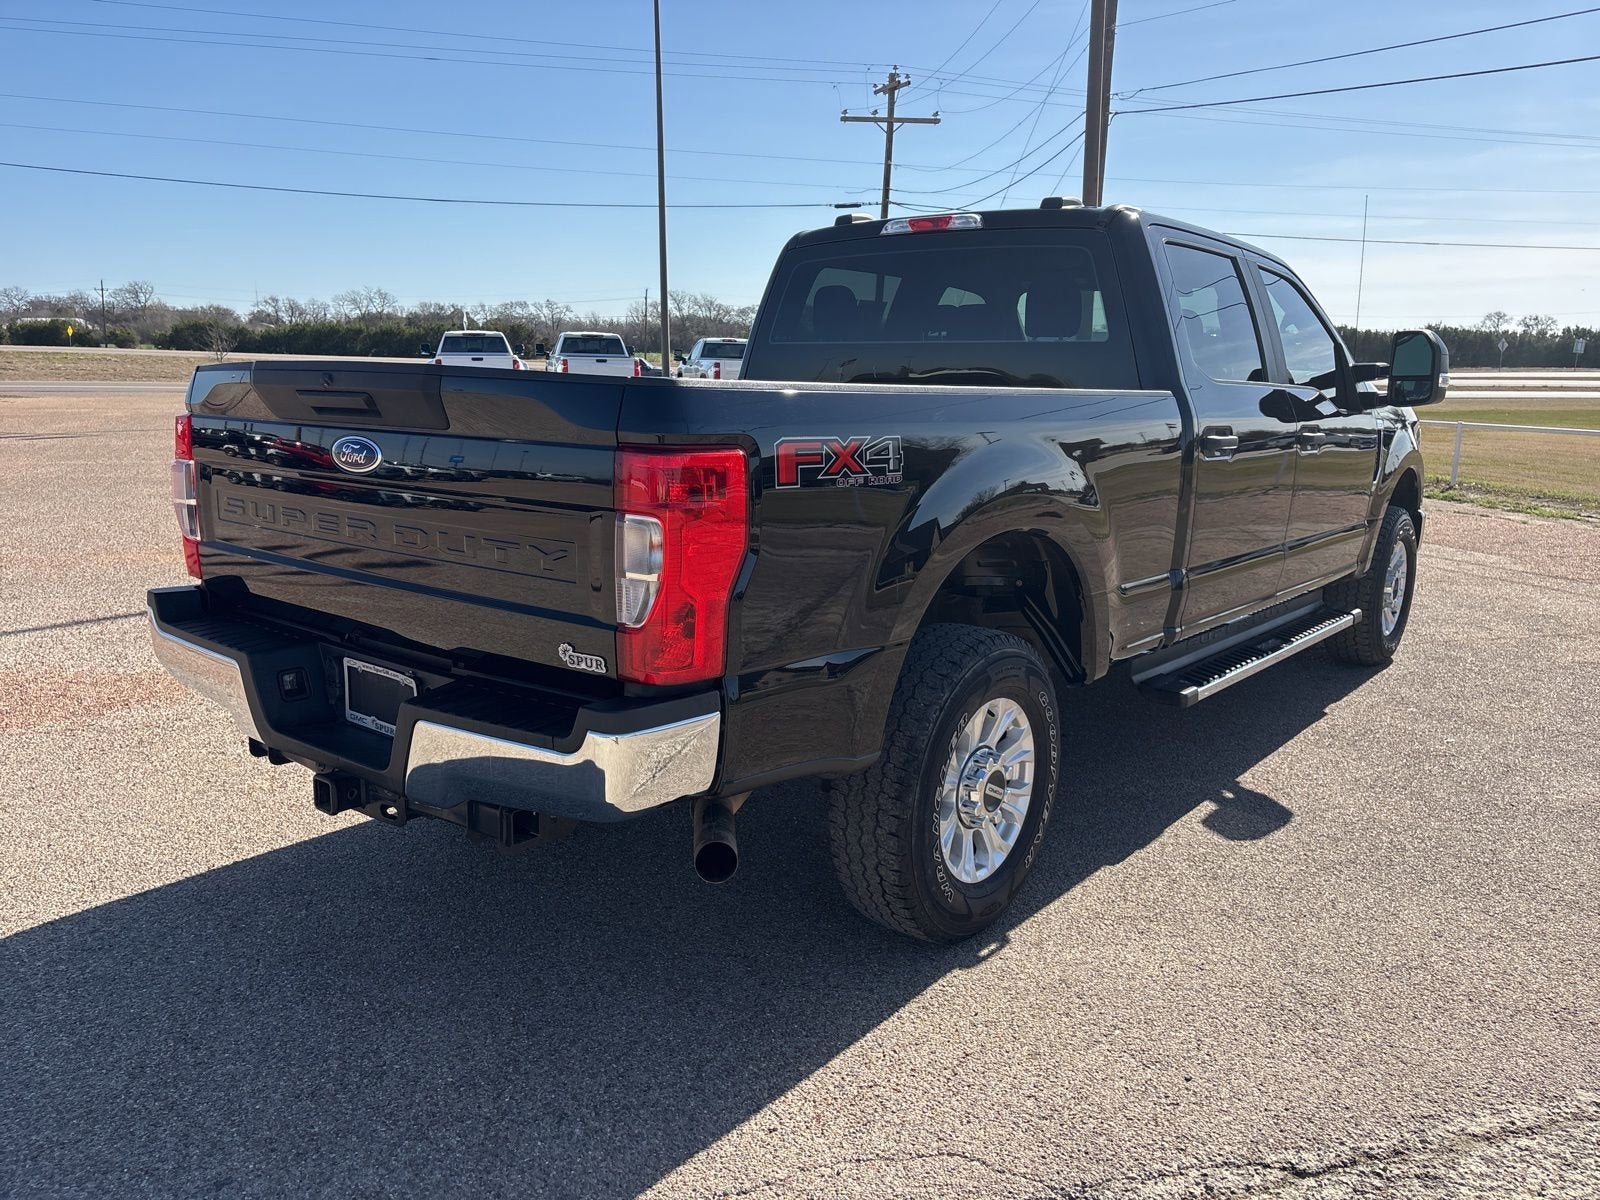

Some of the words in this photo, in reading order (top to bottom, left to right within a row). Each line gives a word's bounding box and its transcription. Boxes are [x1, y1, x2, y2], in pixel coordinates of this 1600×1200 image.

[340, 442, 367, 464] Ford
[774, 435, 903, 489] FX4
[836, 477, 864, 487] OFF
[868, 475, 902, 486] ROAD
[224, 496, 378, 542] SUPER
[393, 524, 569, 574] DUTY
[568, 654, 604, 671] SPUR
[350, 713, 367, 725] GMC
[1025, 691, 1056, 868] GOODYEAR
[932, 712, 969, 903] WRANGLER
